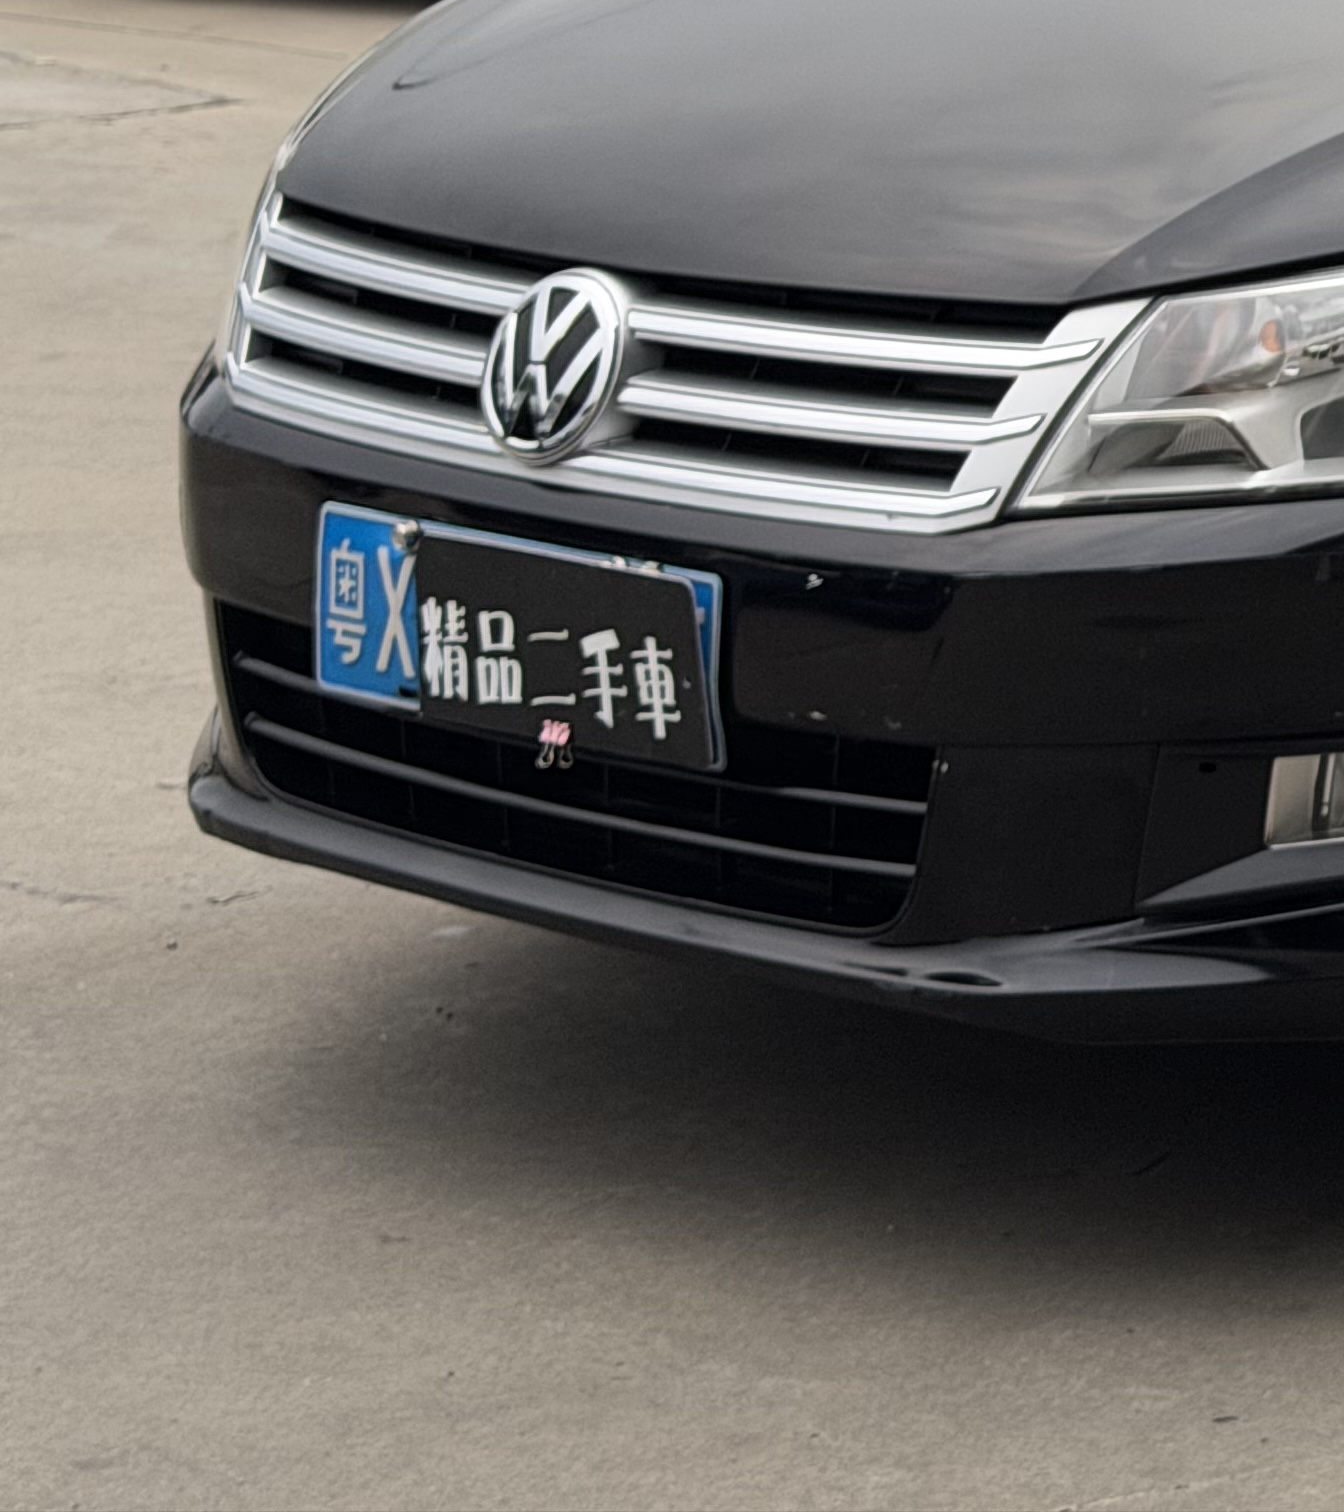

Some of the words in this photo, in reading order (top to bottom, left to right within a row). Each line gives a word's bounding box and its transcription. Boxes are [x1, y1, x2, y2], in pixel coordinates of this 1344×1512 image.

[421, 596, 682, 740] 精品二手車
